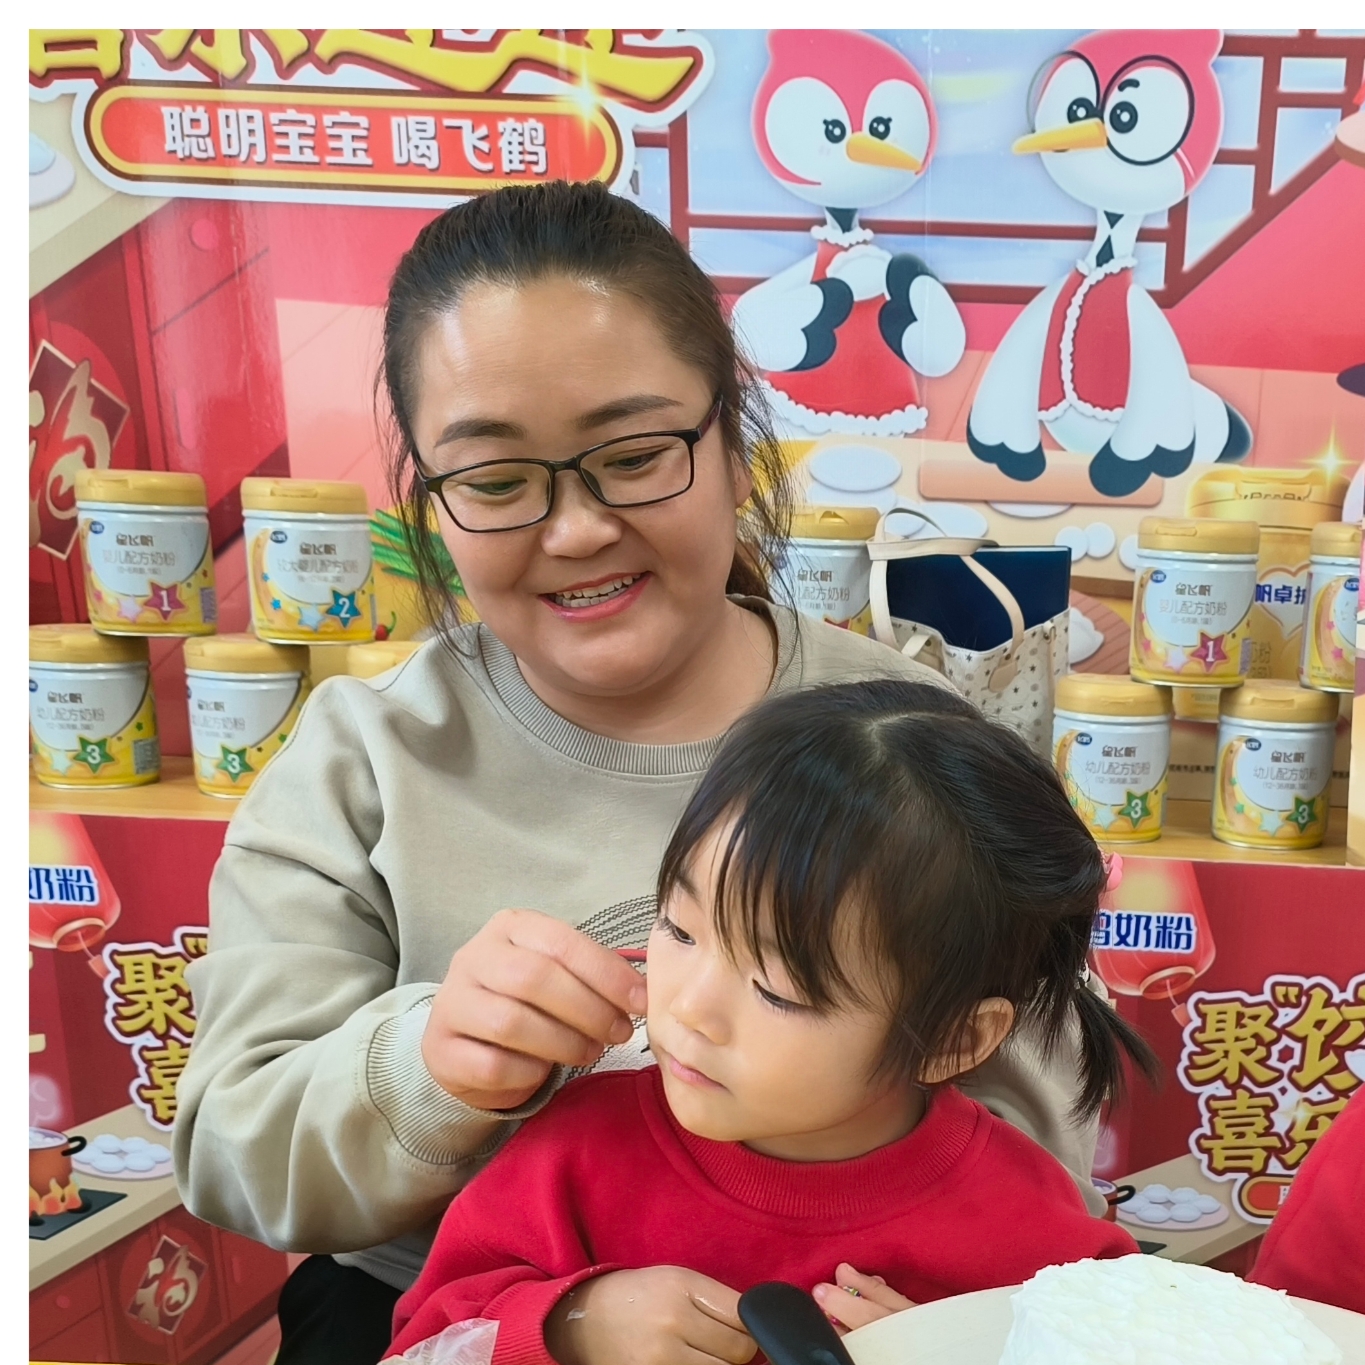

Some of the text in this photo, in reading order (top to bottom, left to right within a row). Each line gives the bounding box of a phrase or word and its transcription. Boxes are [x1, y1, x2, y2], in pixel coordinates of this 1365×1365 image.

[161, 105, 547, 174] 聪明宝宝 喝飞鹤
[159, 590, 171, 612] 1
[338, 598, 351, 618] 2
[1205, 640, 1215, 662] 1
[86, 744, 101, 764] 3
[226, 754, 241, 773] 3
[1130, 799, 1143, 819] 3
[1297, 803, 1310, 824] 3
